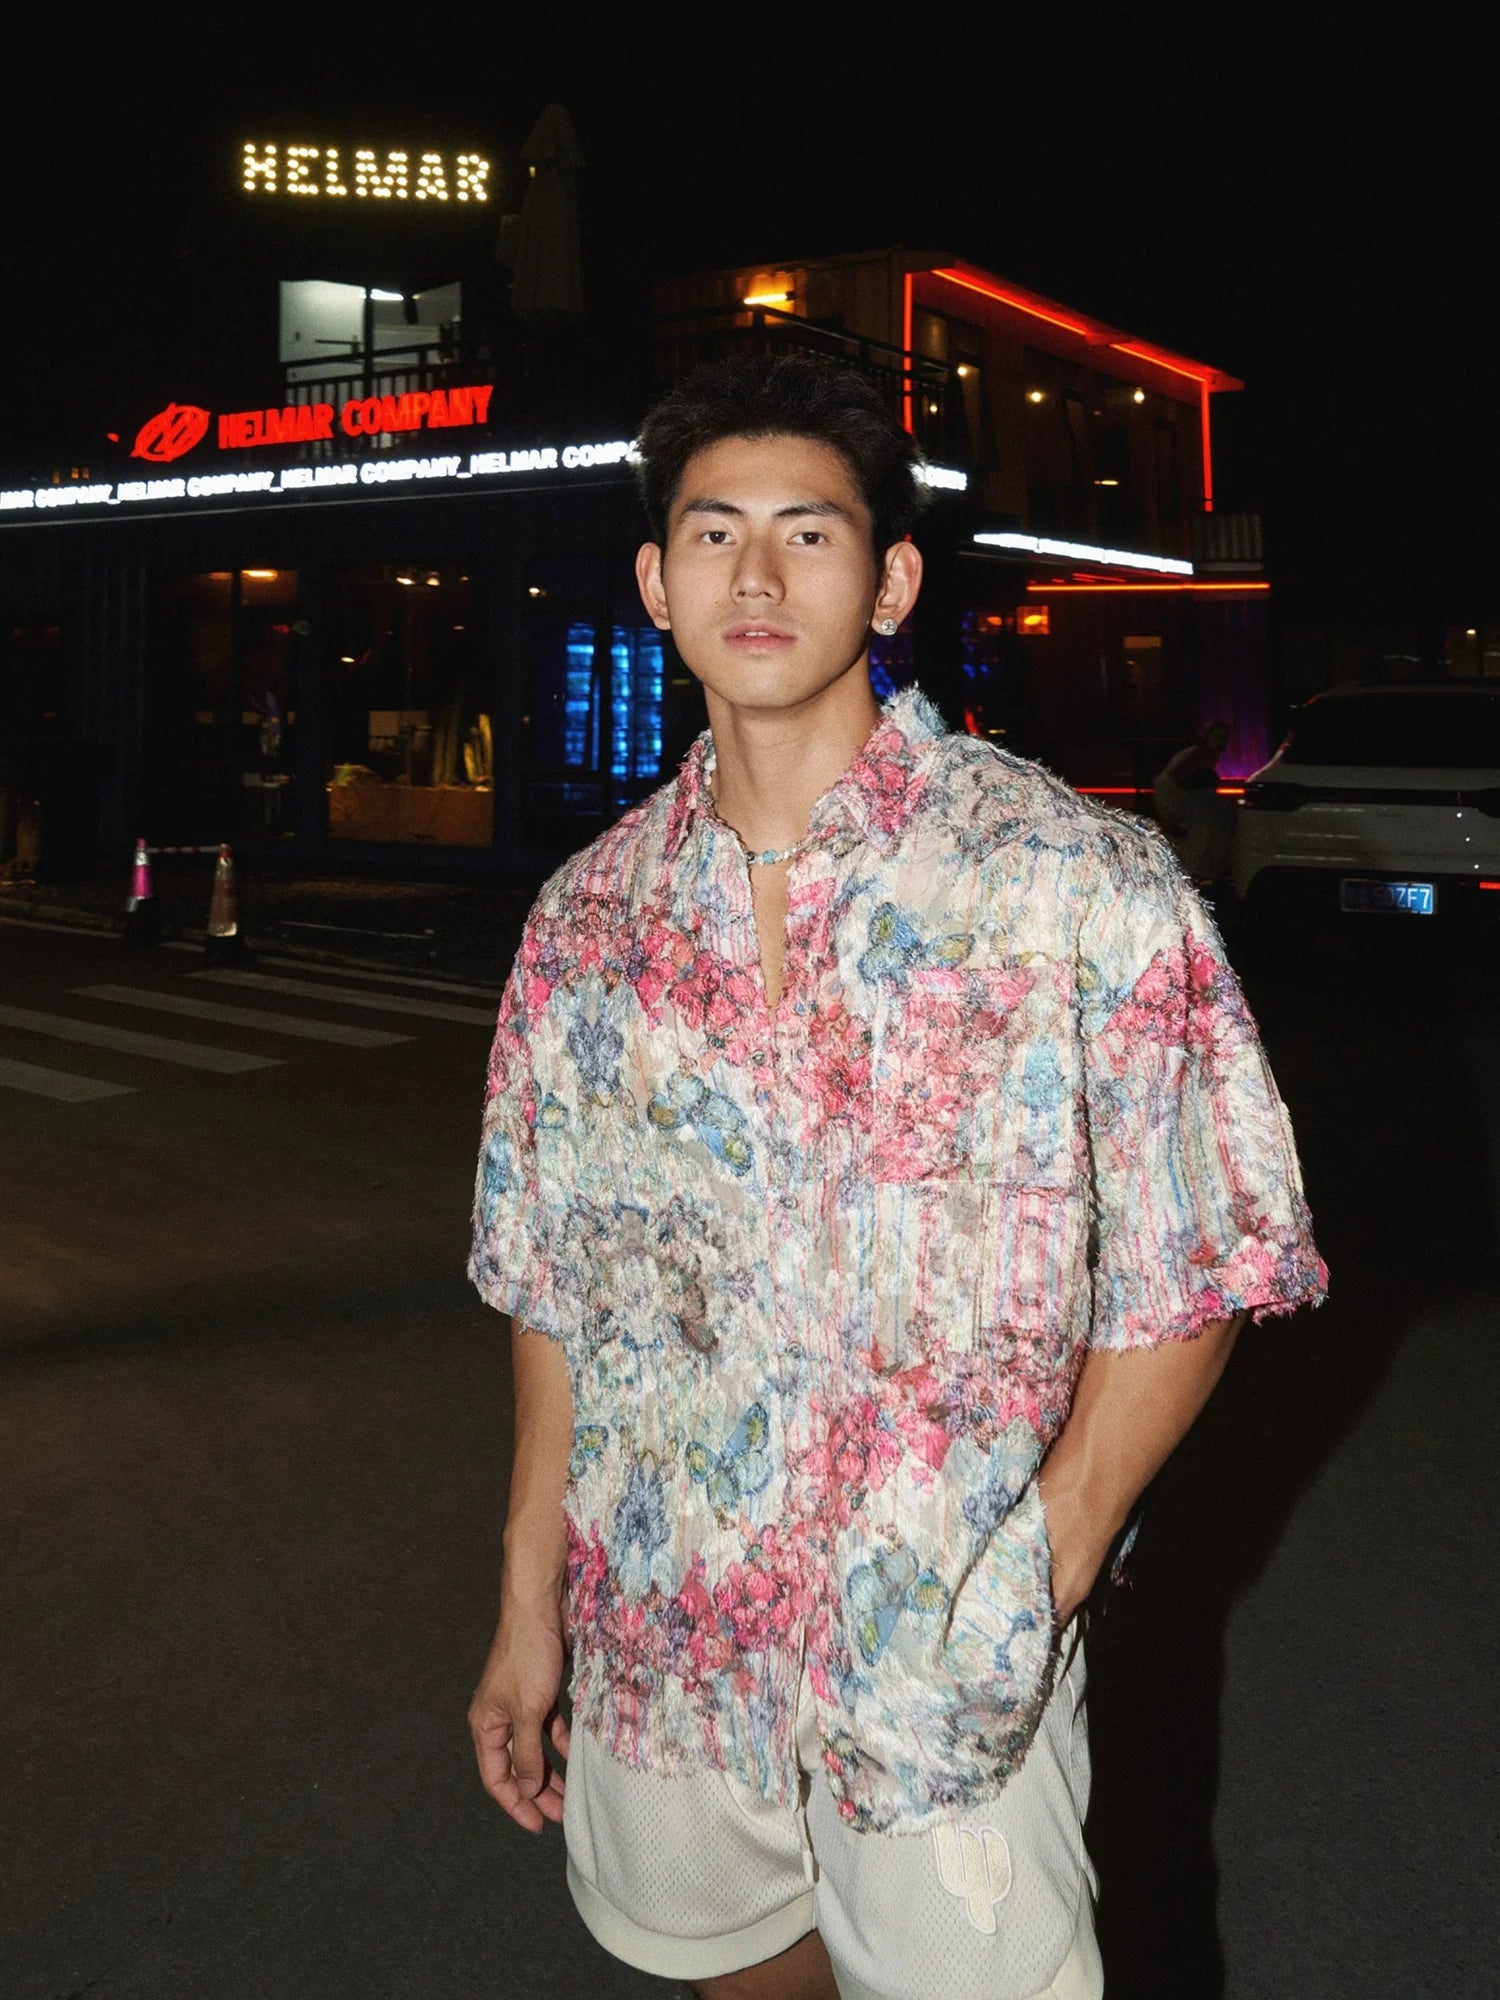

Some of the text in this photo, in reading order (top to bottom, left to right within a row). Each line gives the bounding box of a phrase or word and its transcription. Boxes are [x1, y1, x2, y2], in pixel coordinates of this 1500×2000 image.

[243, 142, 490, 201] HELMAR
[218, 385, 493, 449] HELMAR COMPANY
